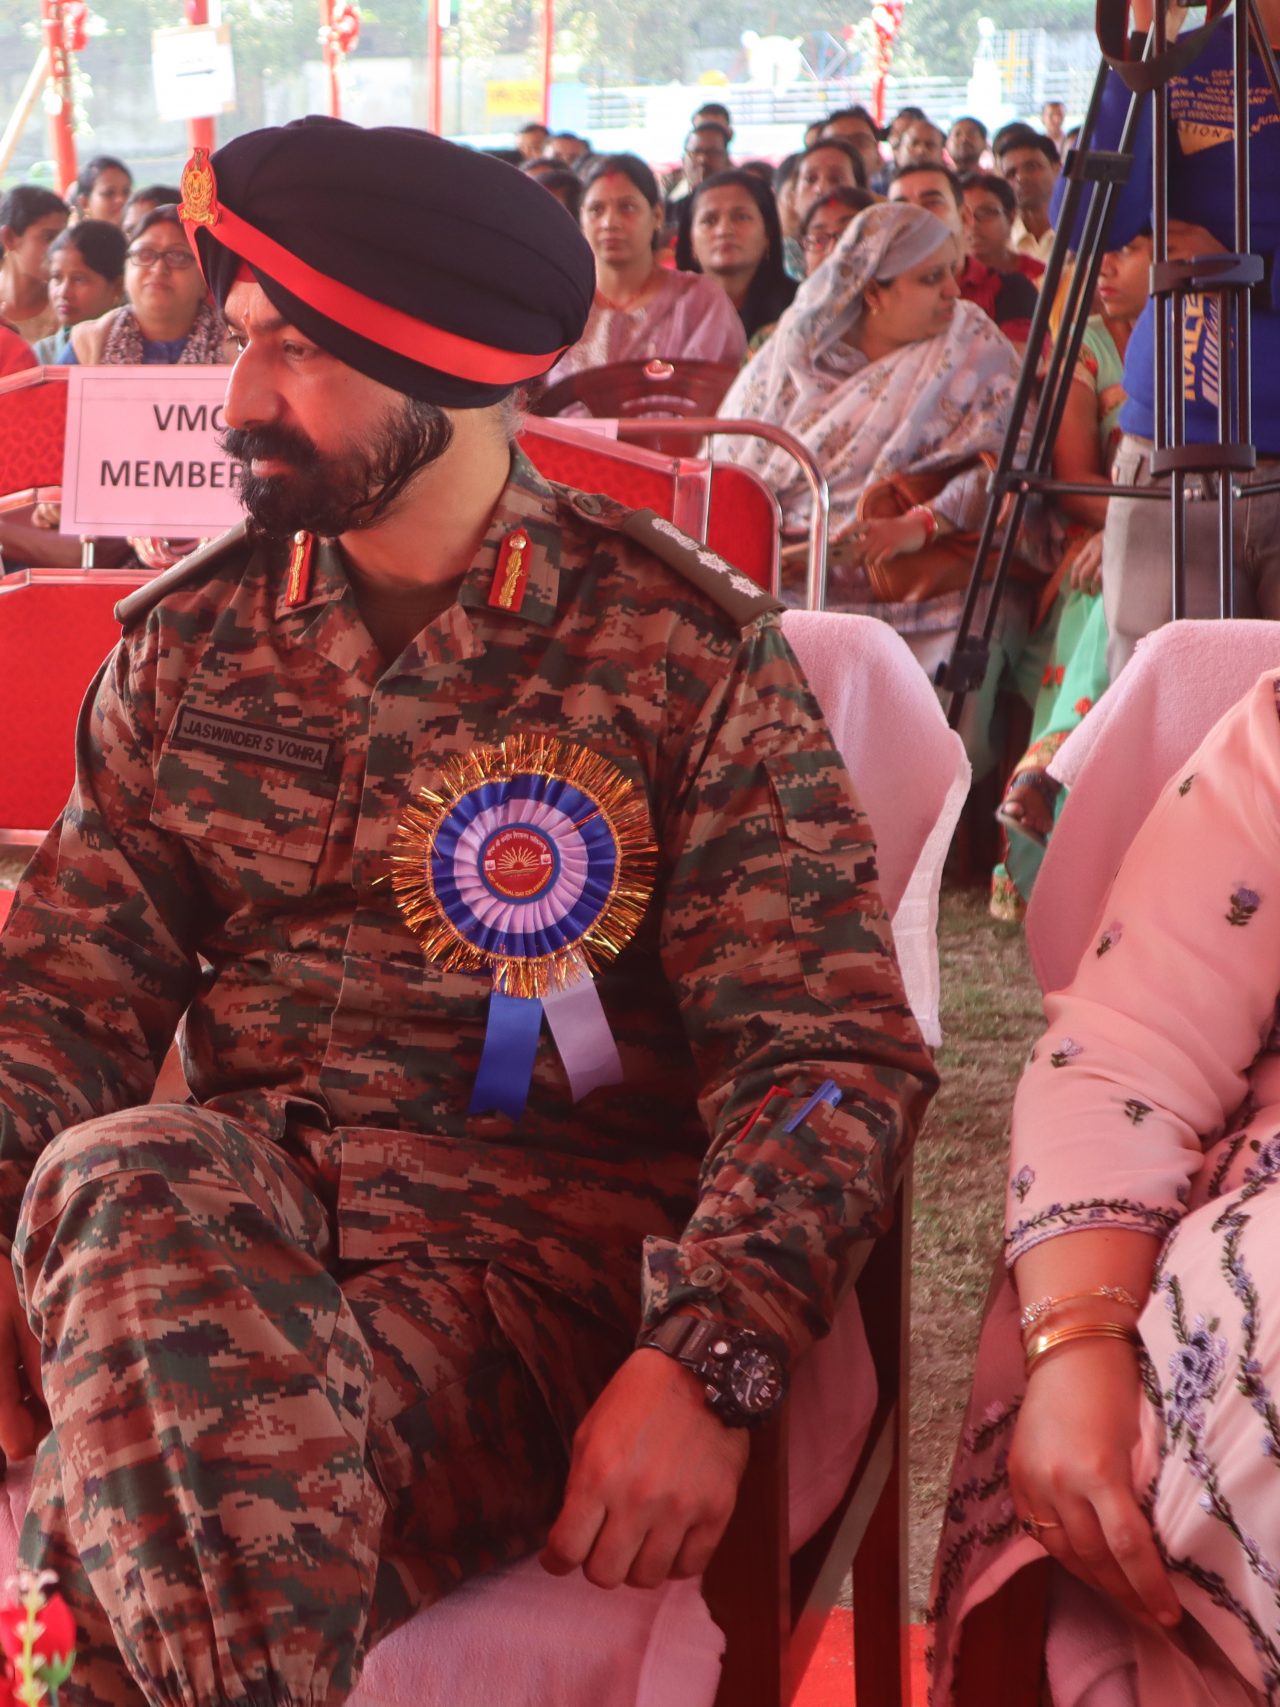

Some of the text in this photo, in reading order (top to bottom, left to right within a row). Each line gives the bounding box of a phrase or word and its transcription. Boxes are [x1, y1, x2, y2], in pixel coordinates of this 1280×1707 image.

[183, 719, 322, 763] JASWINDER S VOHRA
